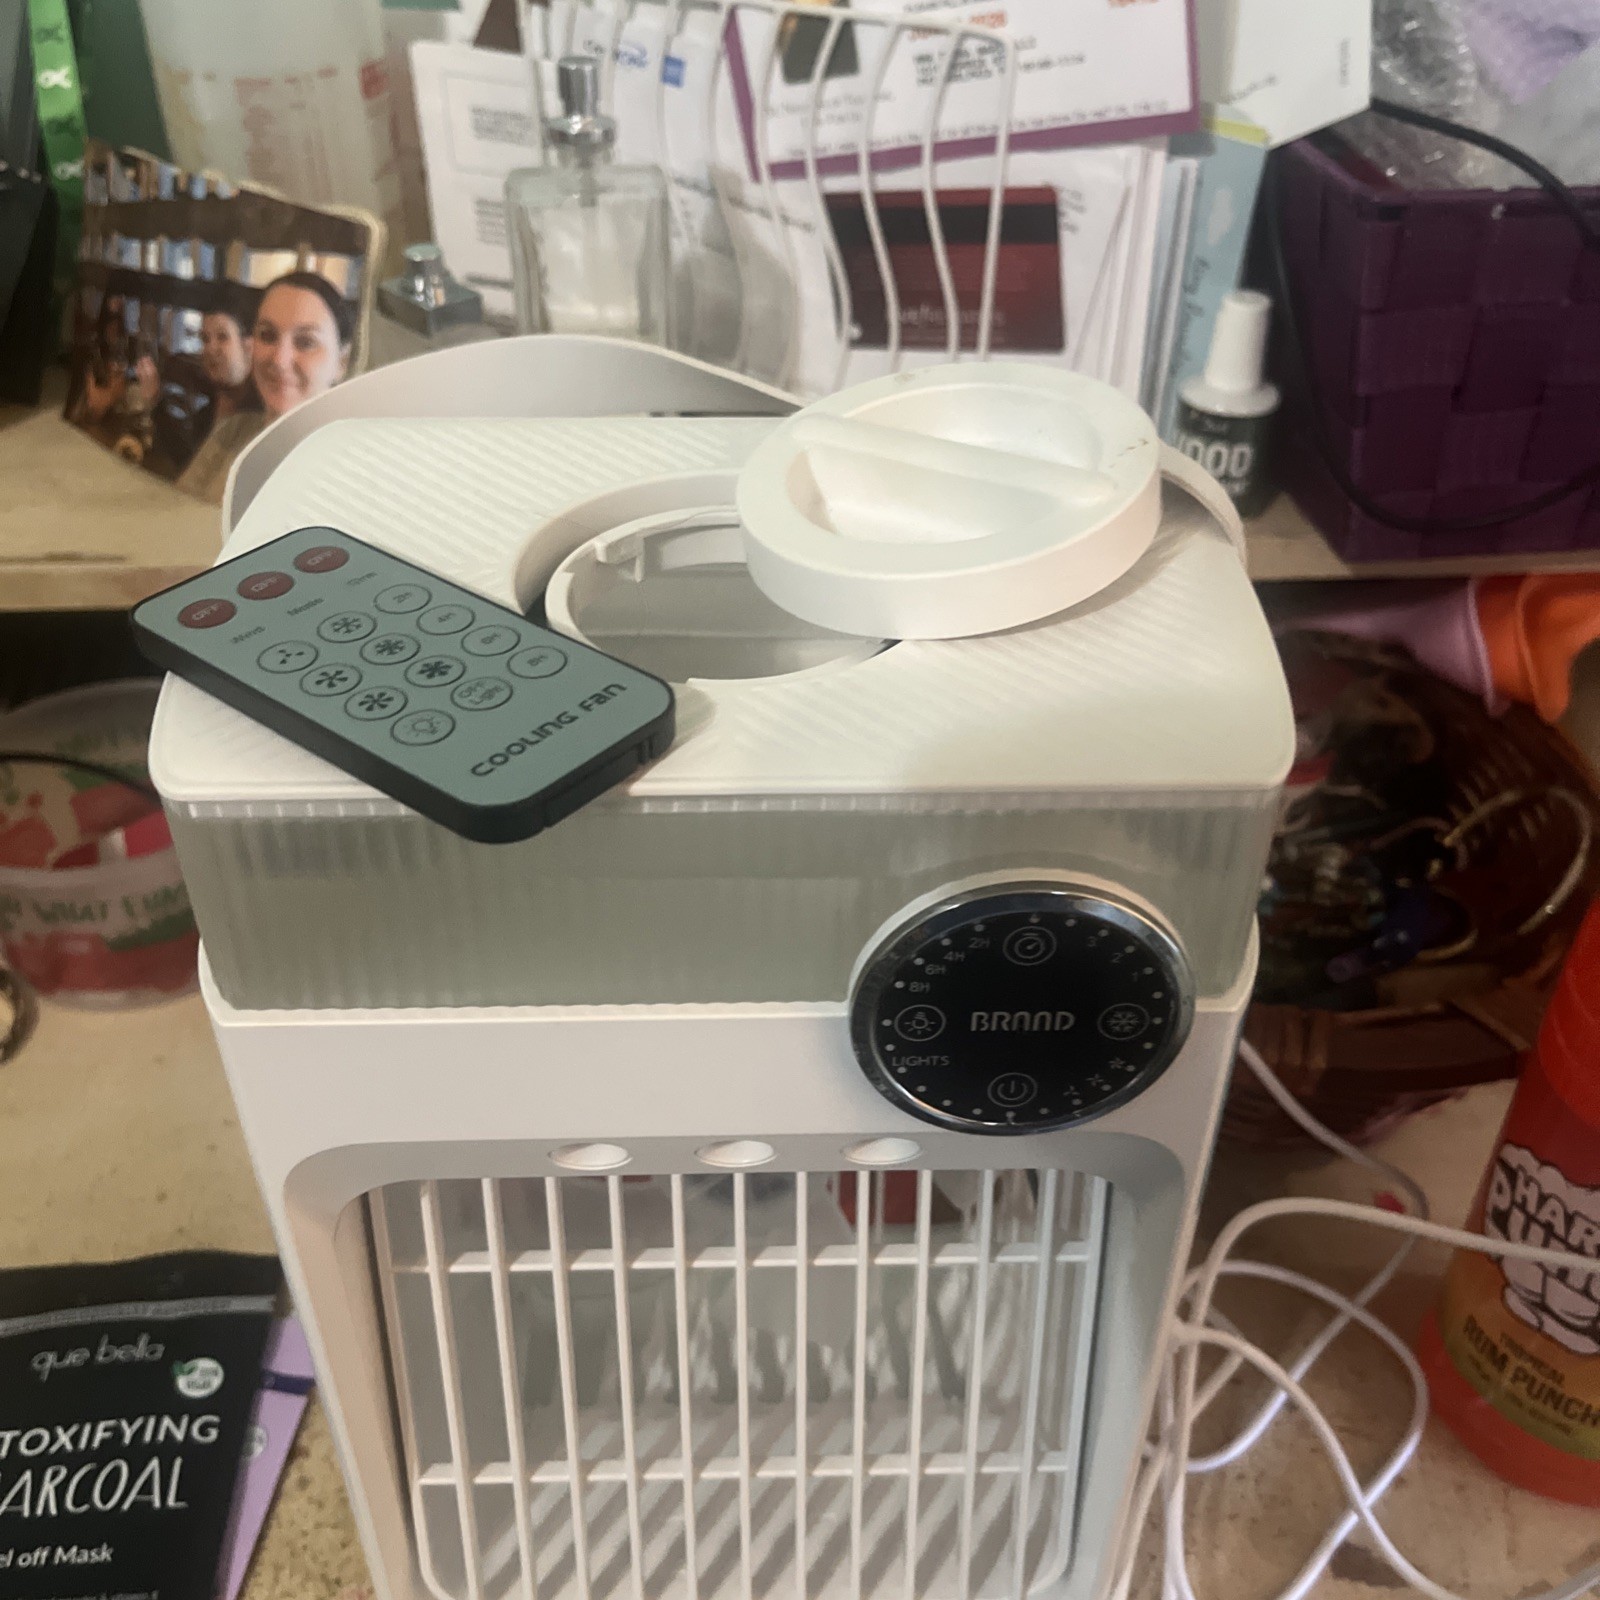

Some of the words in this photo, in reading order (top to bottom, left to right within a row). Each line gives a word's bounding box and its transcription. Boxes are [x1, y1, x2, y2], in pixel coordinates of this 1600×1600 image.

[306, 550, 336, 566] OFF
[250, 576, 280, 593] OFF
[191, 602, 221, 621] OFF
[470, 709, 580, 777] COOLING
[968, 935, 991, 949] 2H
[942, 950, 966, 963] 4H
[924, 963, 947, 976] 6H
[908, 981, 931, 993] 8H
[970, 1010, 1077, 1032] BRAND
[891, 1055, 952, 1068] LIGHTS
[0, 1414, 221, 1459] TOXIFYING
[0, 1455, 188, 1519] ARCOAL
[17, 1545, 52, 1569] off
[53, 1541, 114, 1566] Mask
